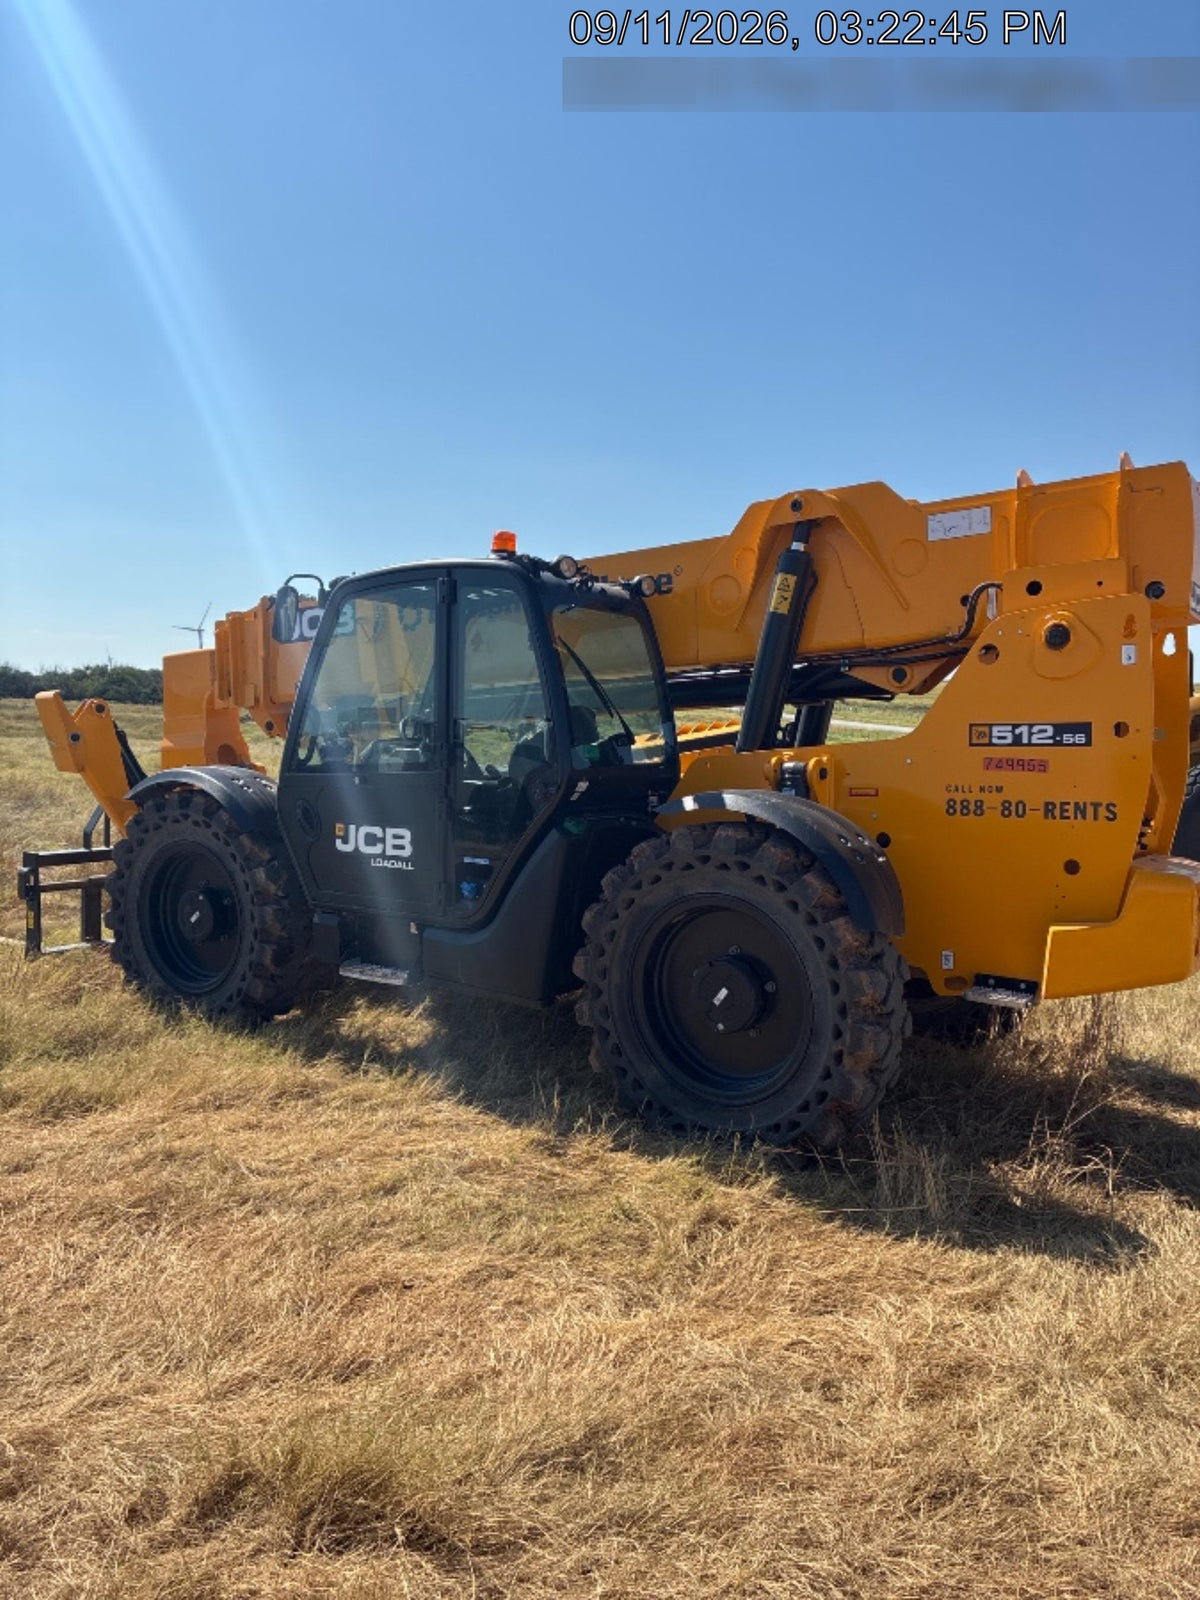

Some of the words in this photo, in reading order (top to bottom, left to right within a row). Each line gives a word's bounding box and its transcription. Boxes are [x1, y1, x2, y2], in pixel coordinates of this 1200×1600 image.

[945, 784, 973, 794] CALL
[979, 784, 1004, 794] NOW
[945, 798, 1118, 822] 888-80-RENTS
[335, 824, 413, 857] JCB
[371, 858, 415, 870] LOADALL
